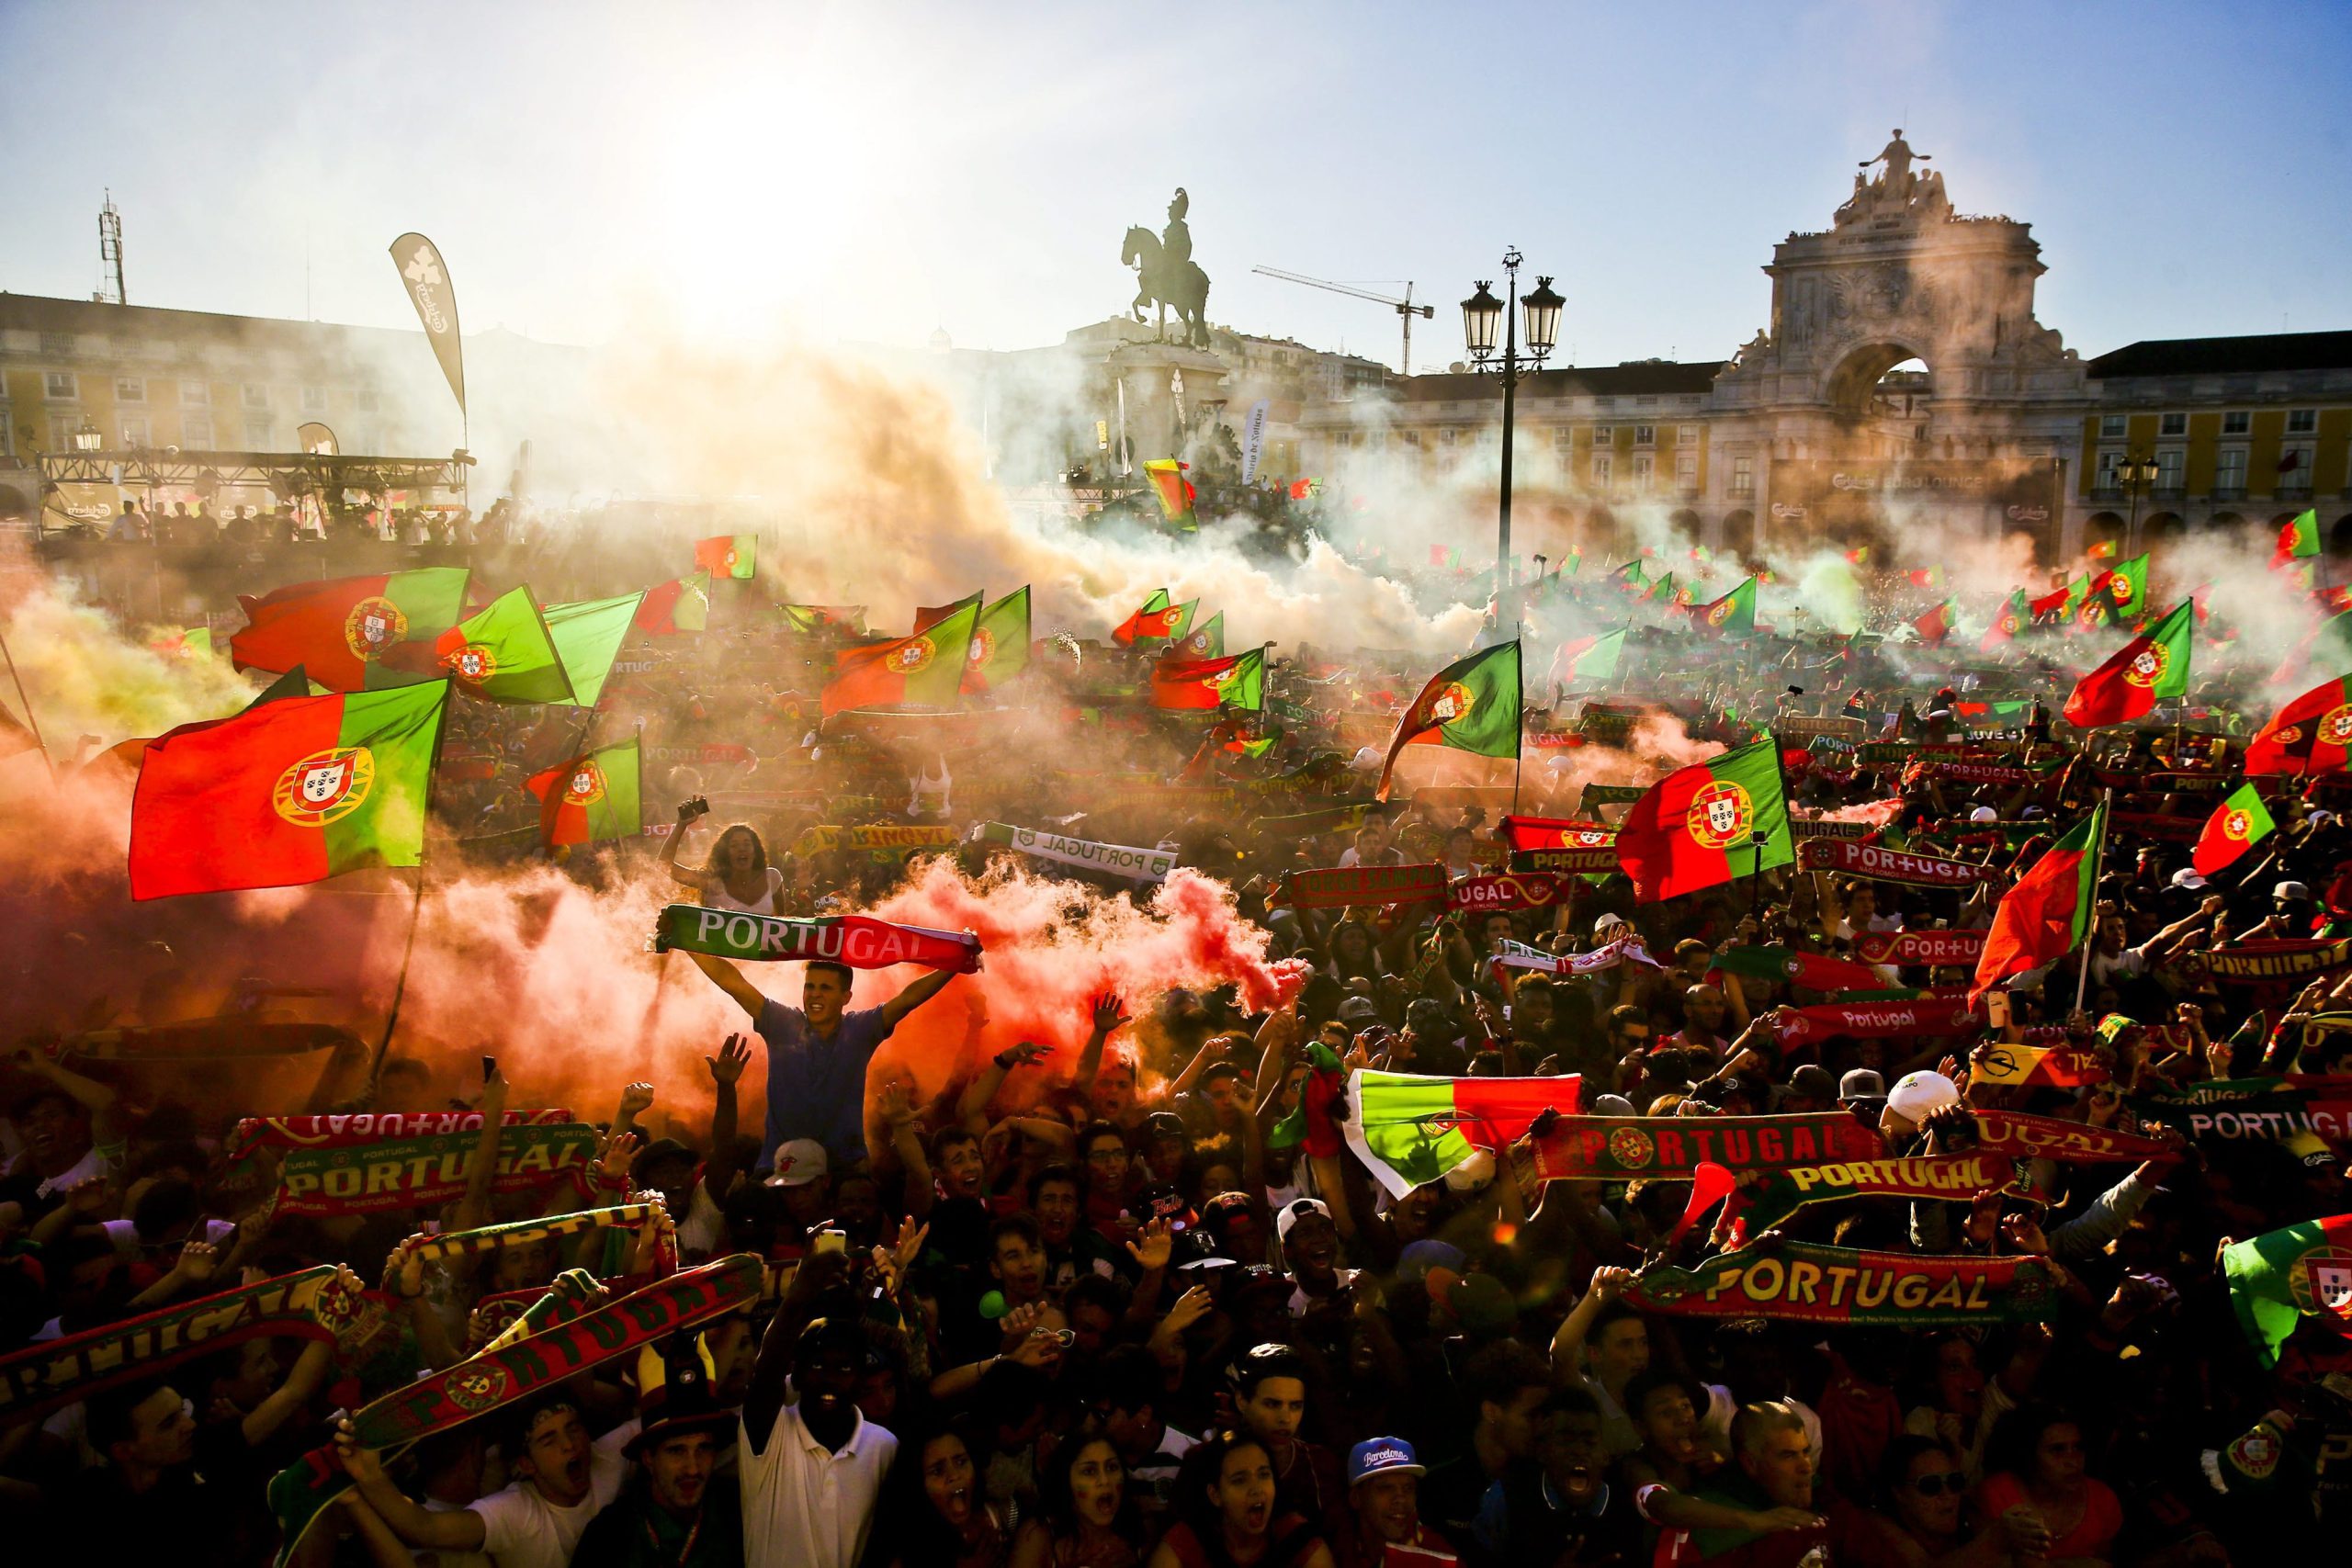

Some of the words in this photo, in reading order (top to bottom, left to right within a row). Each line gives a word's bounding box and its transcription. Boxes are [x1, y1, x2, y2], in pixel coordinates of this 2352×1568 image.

[1967, 730, 2005, 740] JUVE
[696, 910, 930, 961] PORTUGAL
[1905, 940, 1983, 956] PORTU
[1841, 1010, 1917, 1031] Portugal
[362, 1145, 419, 1159] PORTUGAL
[1788, 1156, 1995, 1191] PORTUGAL
[344, 1195, 400, 1209] PORTUGAL
[1705, 1258, 1992, 1310] PORTUGAL
[1363, 1448, 1409, 1468] Barcelona
